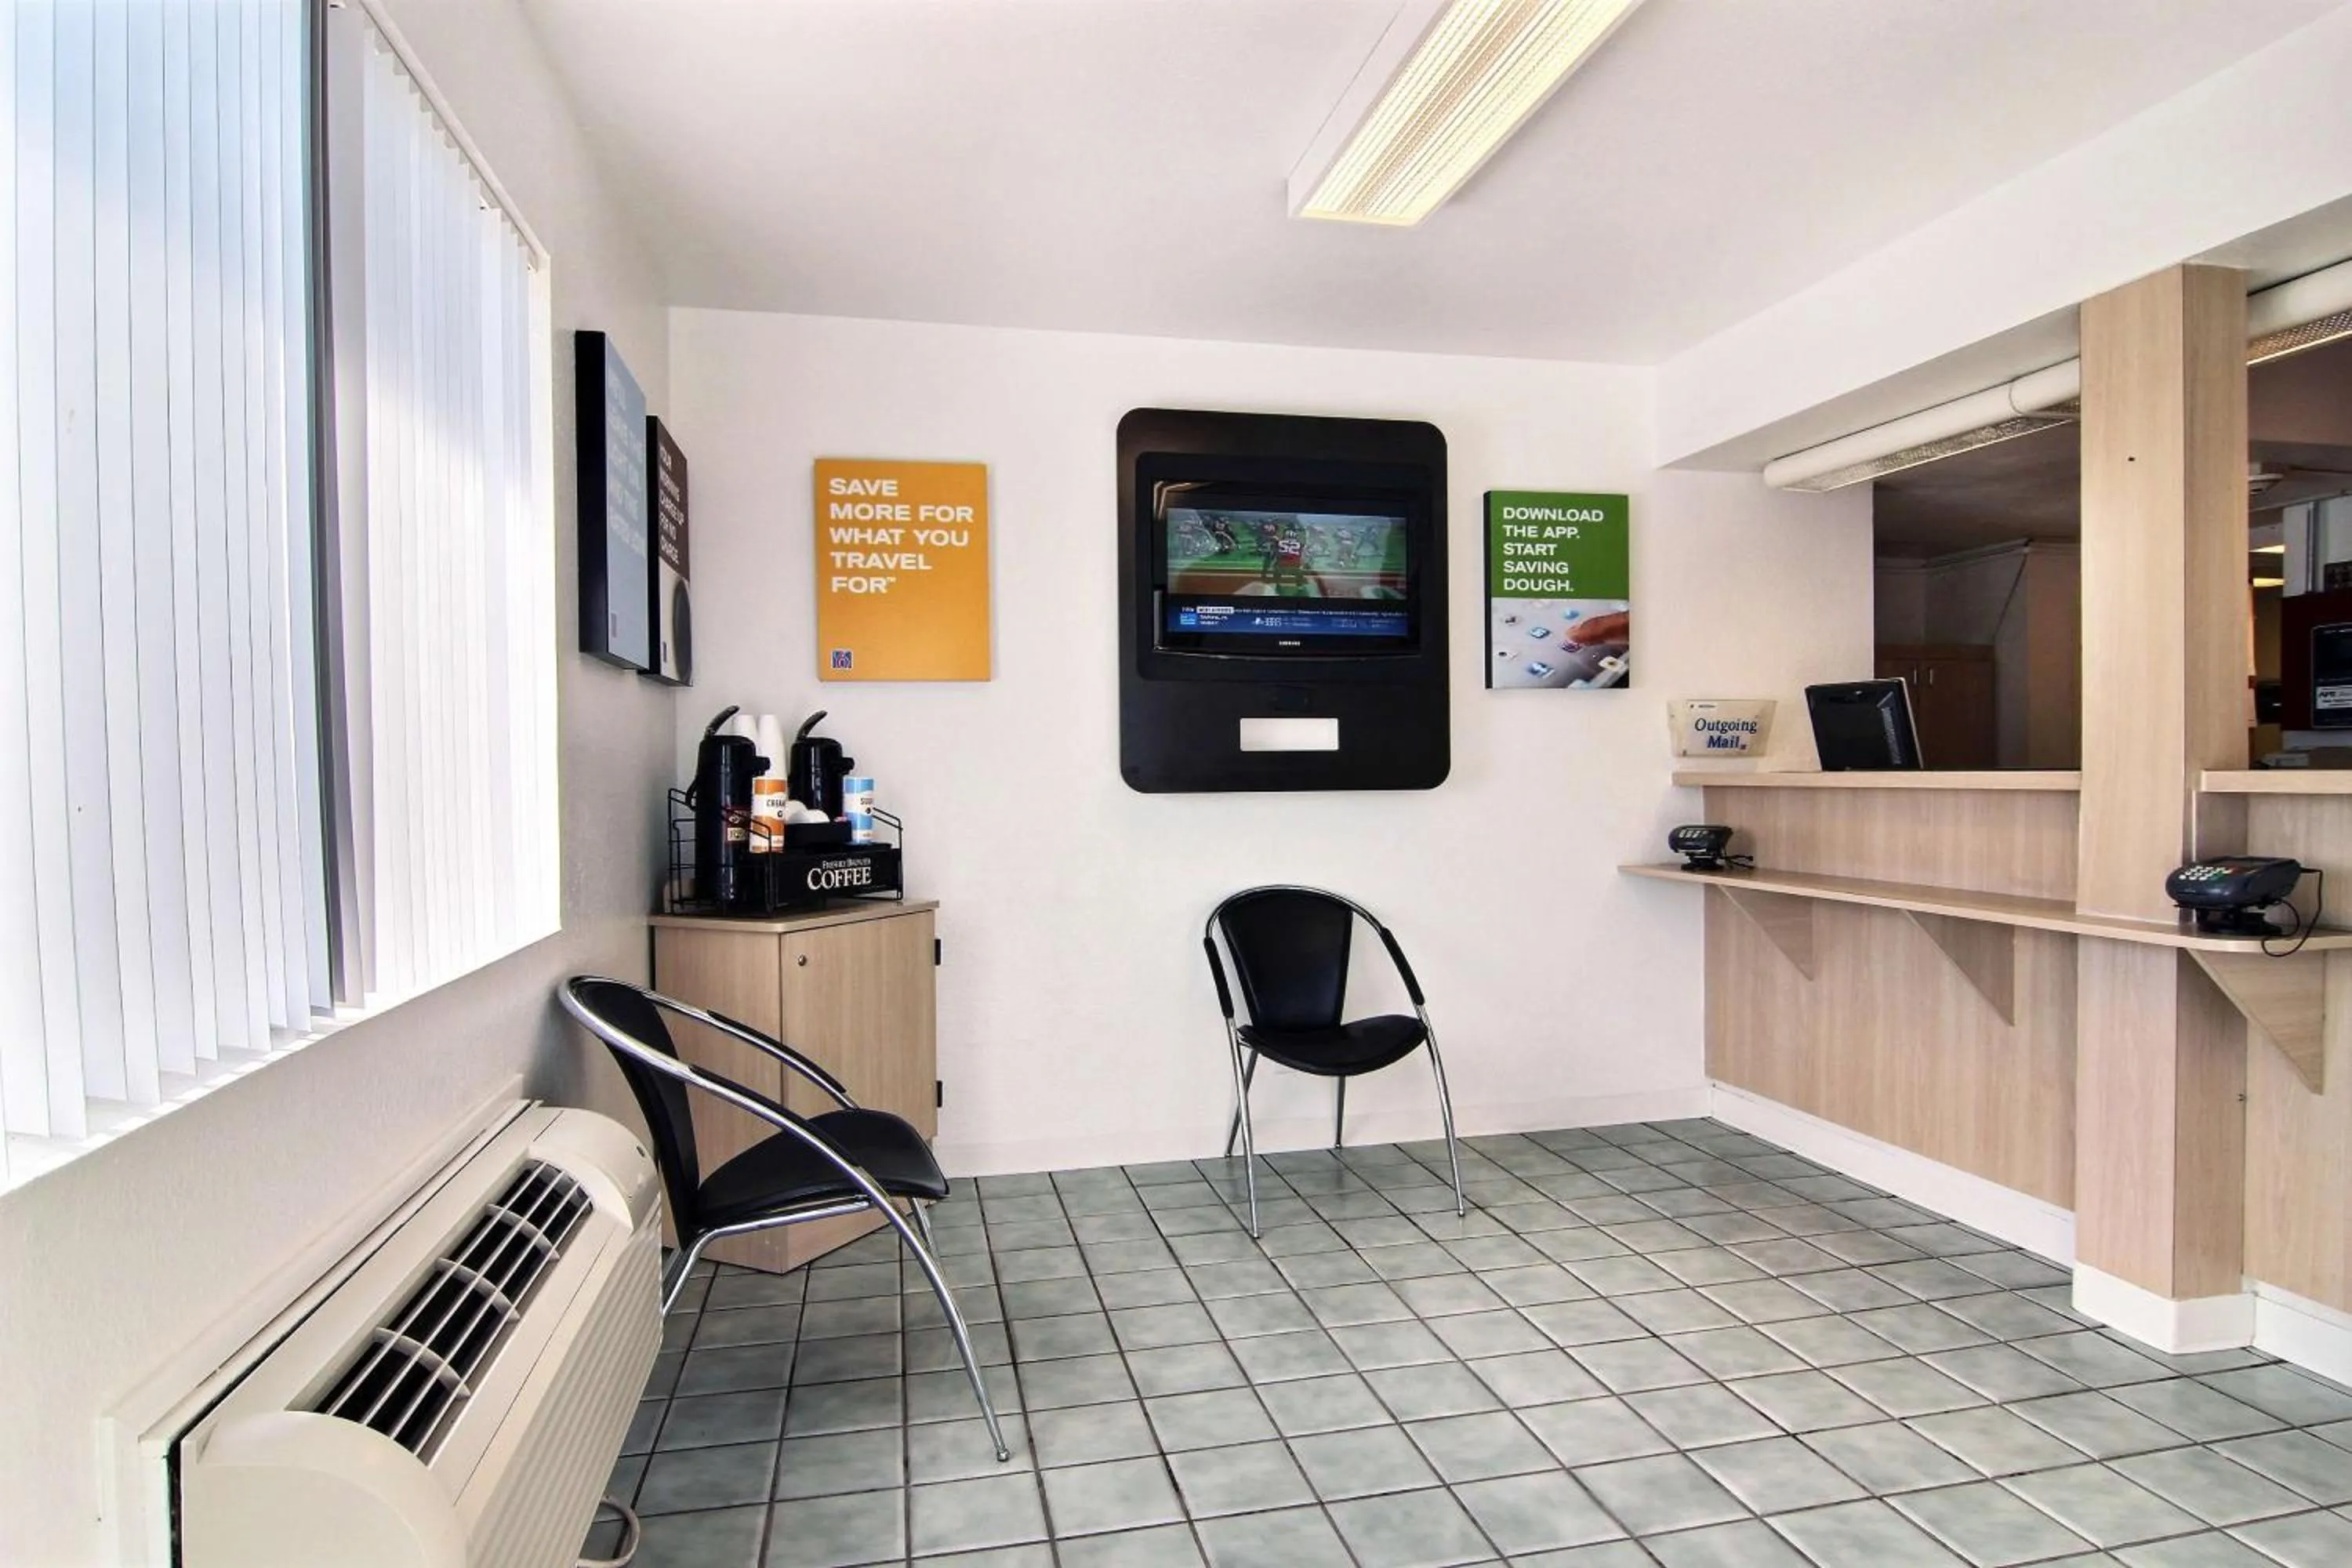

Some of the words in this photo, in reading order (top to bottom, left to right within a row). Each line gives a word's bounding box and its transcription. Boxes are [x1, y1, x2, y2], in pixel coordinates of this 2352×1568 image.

[829, 477, 898, 496] SAVE
[829, 503, 911, 521] MORE
[919, 505, 974, 523] FOR
[1503, 507, 1604, 522] DOWNLOAD
[829, 527, 905, 545] WHAT
[913, 529, 969, 546] YOU
[1503, 525, 1539, 538] THE
[1543, 527, 1581, 539] APP.
[1503, 543, 1558, 556] START
[829, 551, 931, 570] TRAVEL
[1503, 561, 1569, 575] SAVING
[1503, 579, 1574, 592] DOUGH.
[1694, 717, 1758, 734] Outgoing
[1707, 735, 1740, 748] Mail
[808, 866, 872, 890] COFFEE
